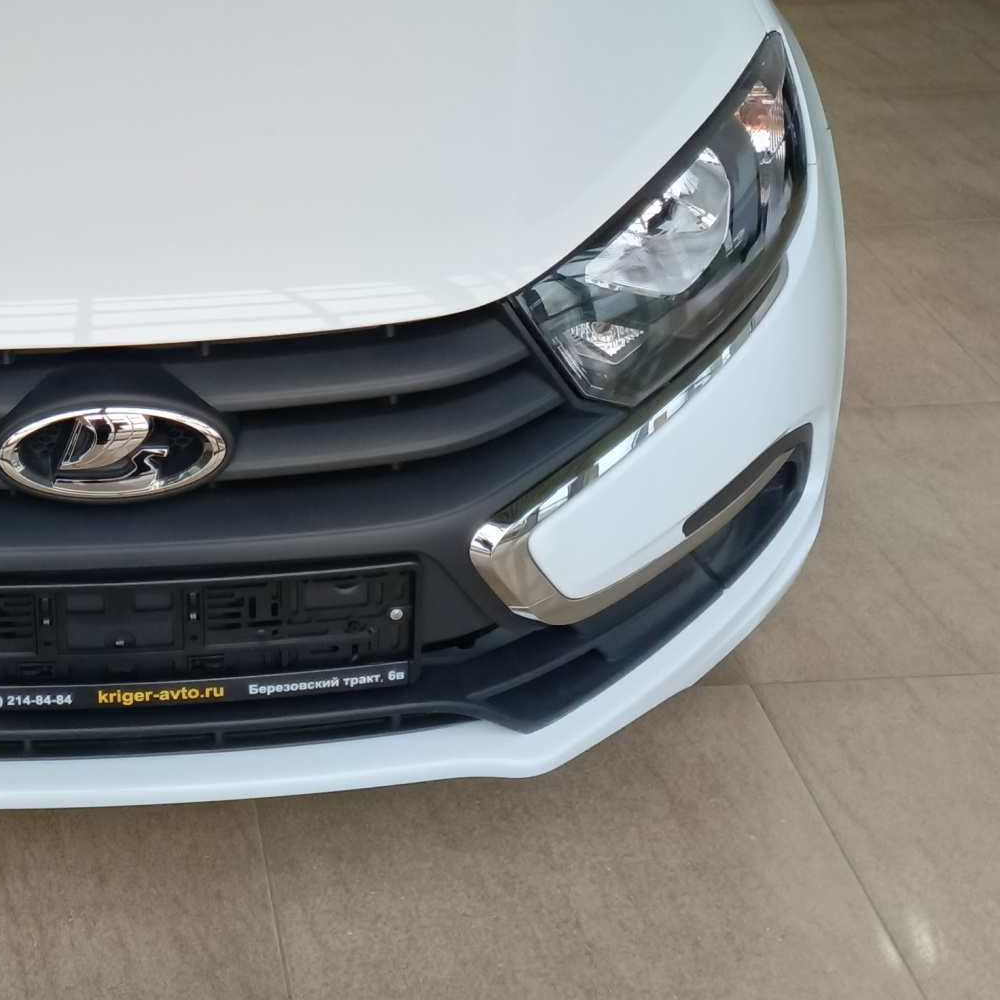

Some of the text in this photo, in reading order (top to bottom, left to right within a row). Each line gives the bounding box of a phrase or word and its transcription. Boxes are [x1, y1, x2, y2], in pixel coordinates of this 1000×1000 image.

[248, 677, 340, 695] Березовский
[6, 694, 73, 706] 214-84-84
[98, 687, 225, 706] kriger-avto.ru
